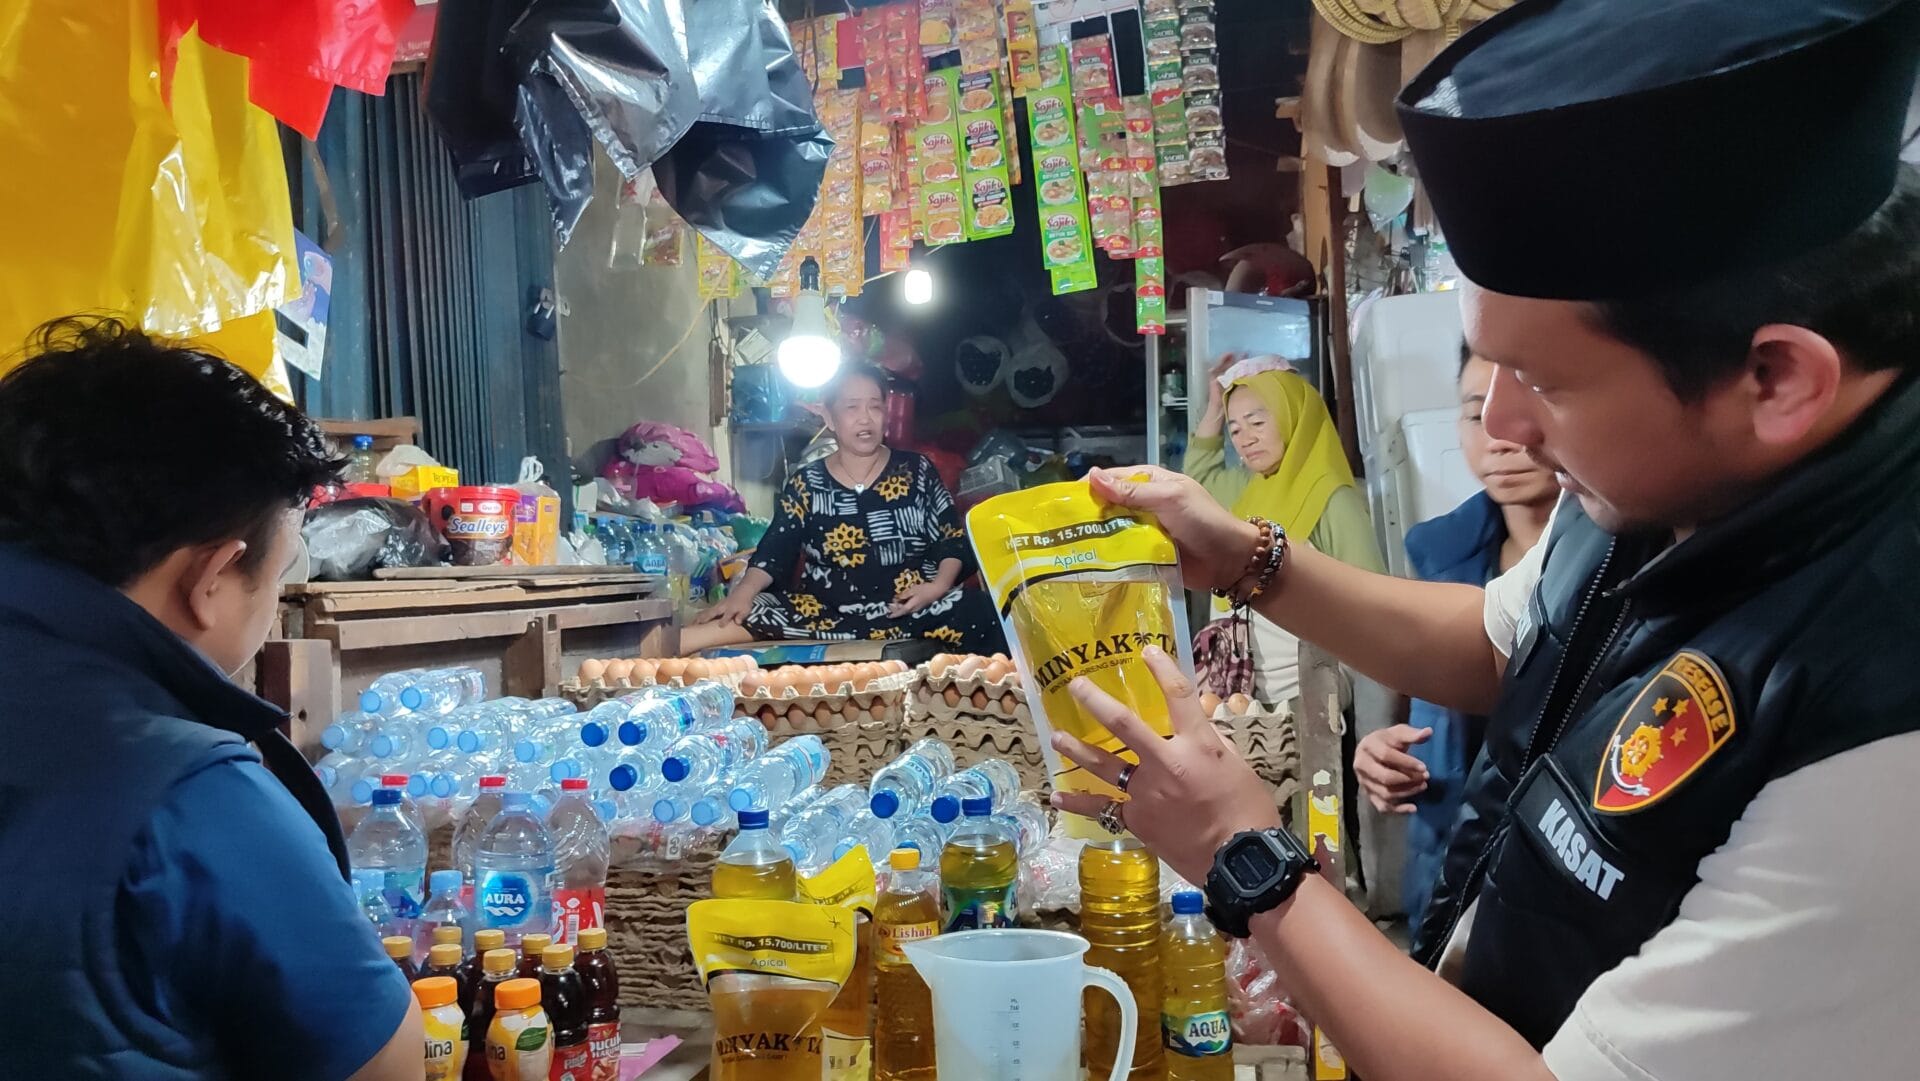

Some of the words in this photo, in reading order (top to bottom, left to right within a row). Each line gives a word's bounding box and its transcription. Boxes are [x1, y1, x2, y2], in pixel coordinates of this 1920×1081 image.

[451, 519, 506, 535] Sealleys
[1005, 536, 1030, 551] HET
[1033, 534, 1055, 547] Rp.
[1053, 548, 1097, 568] Apical
[1538, 798, 1625, 901] KASAT
[485, 893, 526, 905] AURA
[759, 937, 829, 952] 15.700/LITER
[750, 958, 787, 969] Apical
[1188, 1019, 1227, 1038] AQUA
